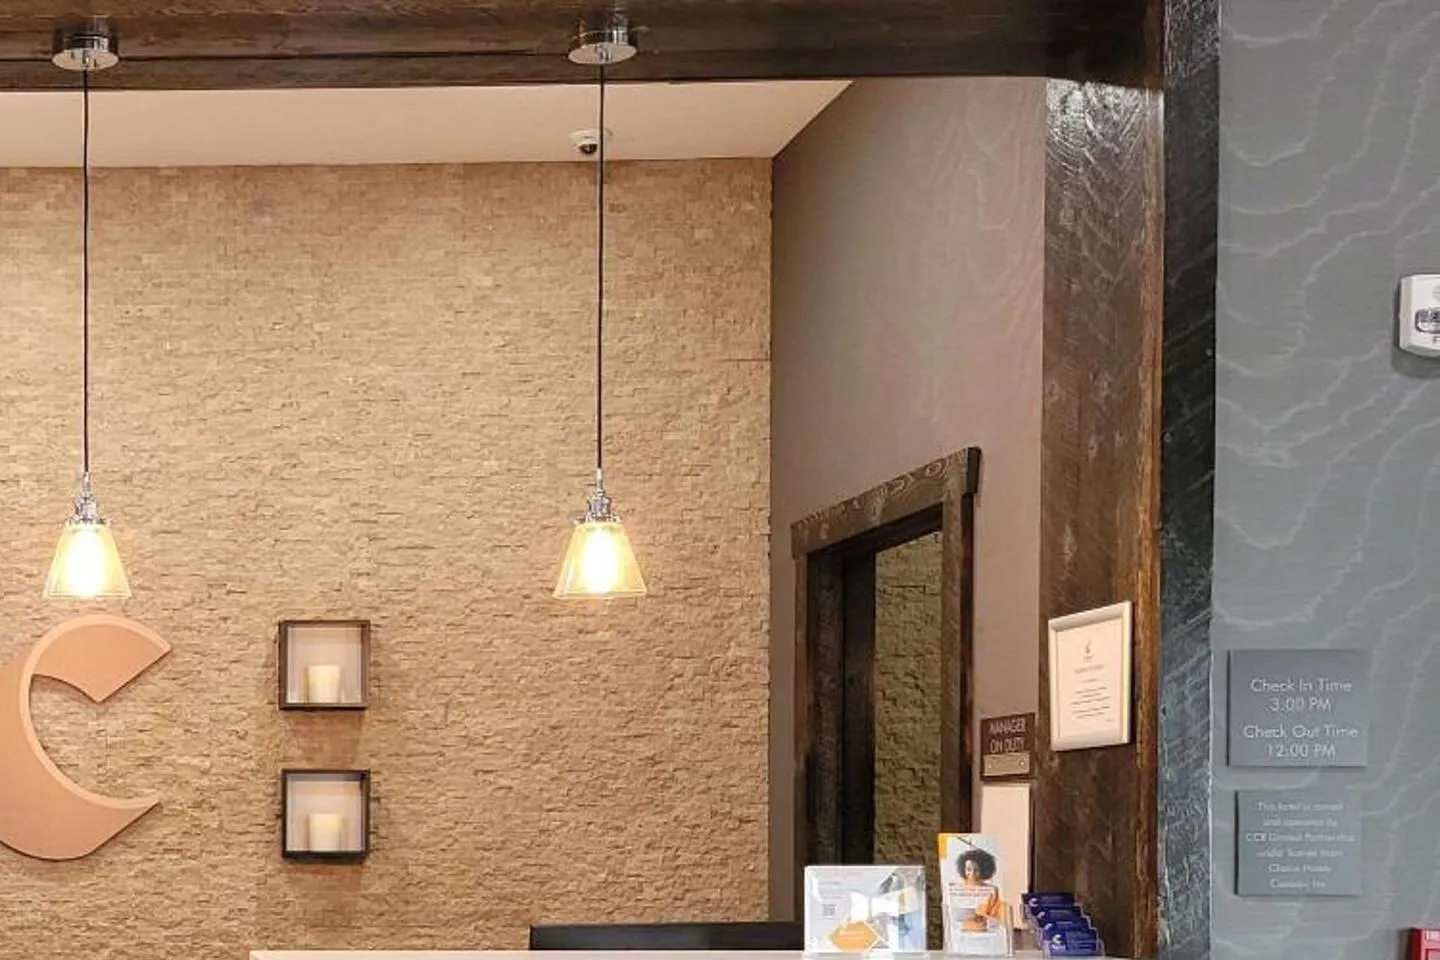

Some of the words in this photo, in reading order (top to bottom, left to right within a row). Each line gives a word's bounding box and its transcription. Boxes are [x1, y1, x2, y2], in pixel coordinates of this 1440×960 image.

[1250, 678, 1295, 692] Check
[1300, 679, 1312, 692] In
[1318, 678, 1352, 692] Time
[1269, 697, 1305, 711] 3:00
[1309, 697, 1332, 712] PM
[989, 717, 1026, 734] MANAGER
[1243, 724, 1288, 738] Check
[1292, 725, 1319, 738] Out
[1324, 724, 1359, 738] Time
[990, 739, 1003, 753] ON
[1004, 737, 1025, 752] DUTY
[1267, 743, 1308, 757] 12:00
[1312, 744, 1336, 758] PM
